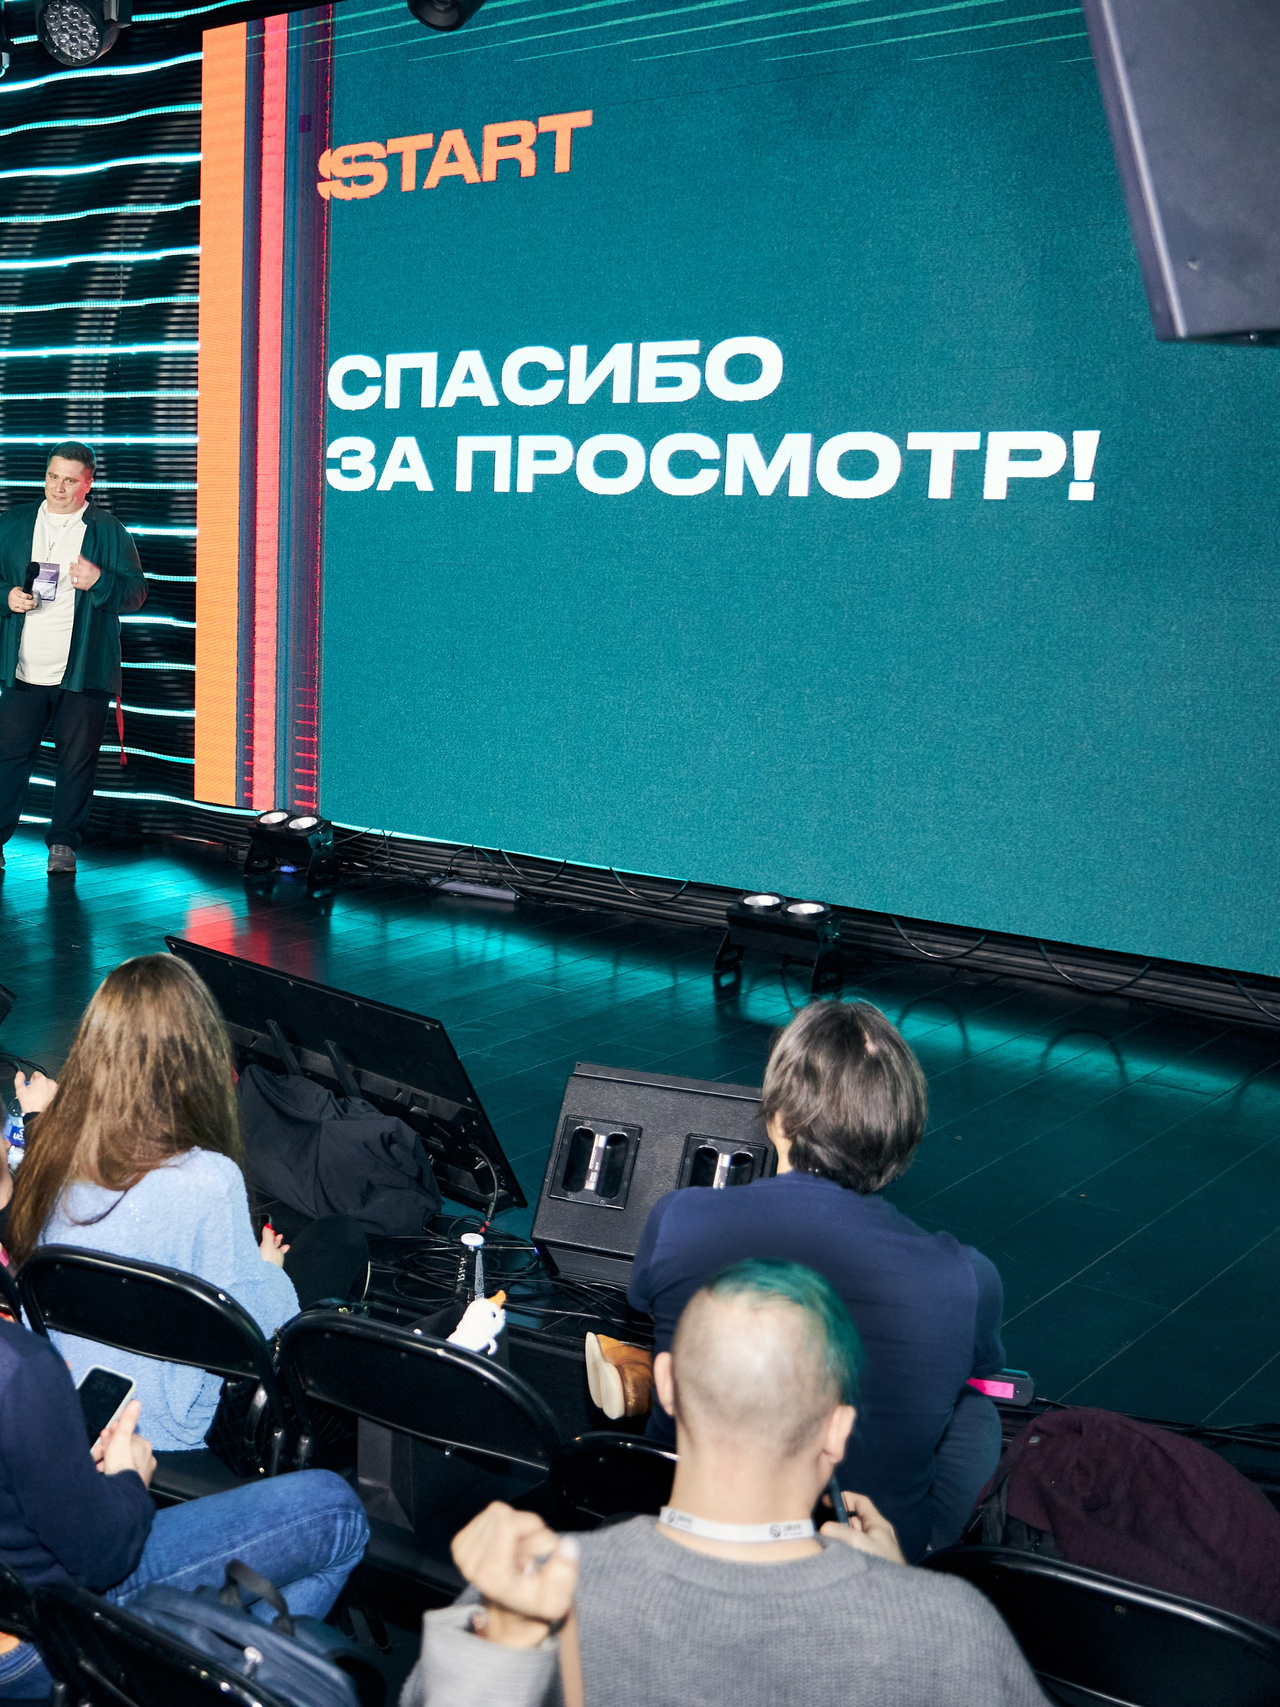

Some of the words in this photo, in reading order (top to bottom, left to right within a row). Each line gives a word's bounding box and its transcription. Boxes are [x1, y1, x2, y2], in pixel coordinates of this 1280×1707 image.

[317, 110, 593, 201] START
[326, 336, 784, 411] СПАСИБО
[325, 435, 434, 495] ЗА
[455, 429, 1101, 501] ПРОСМОТР!
